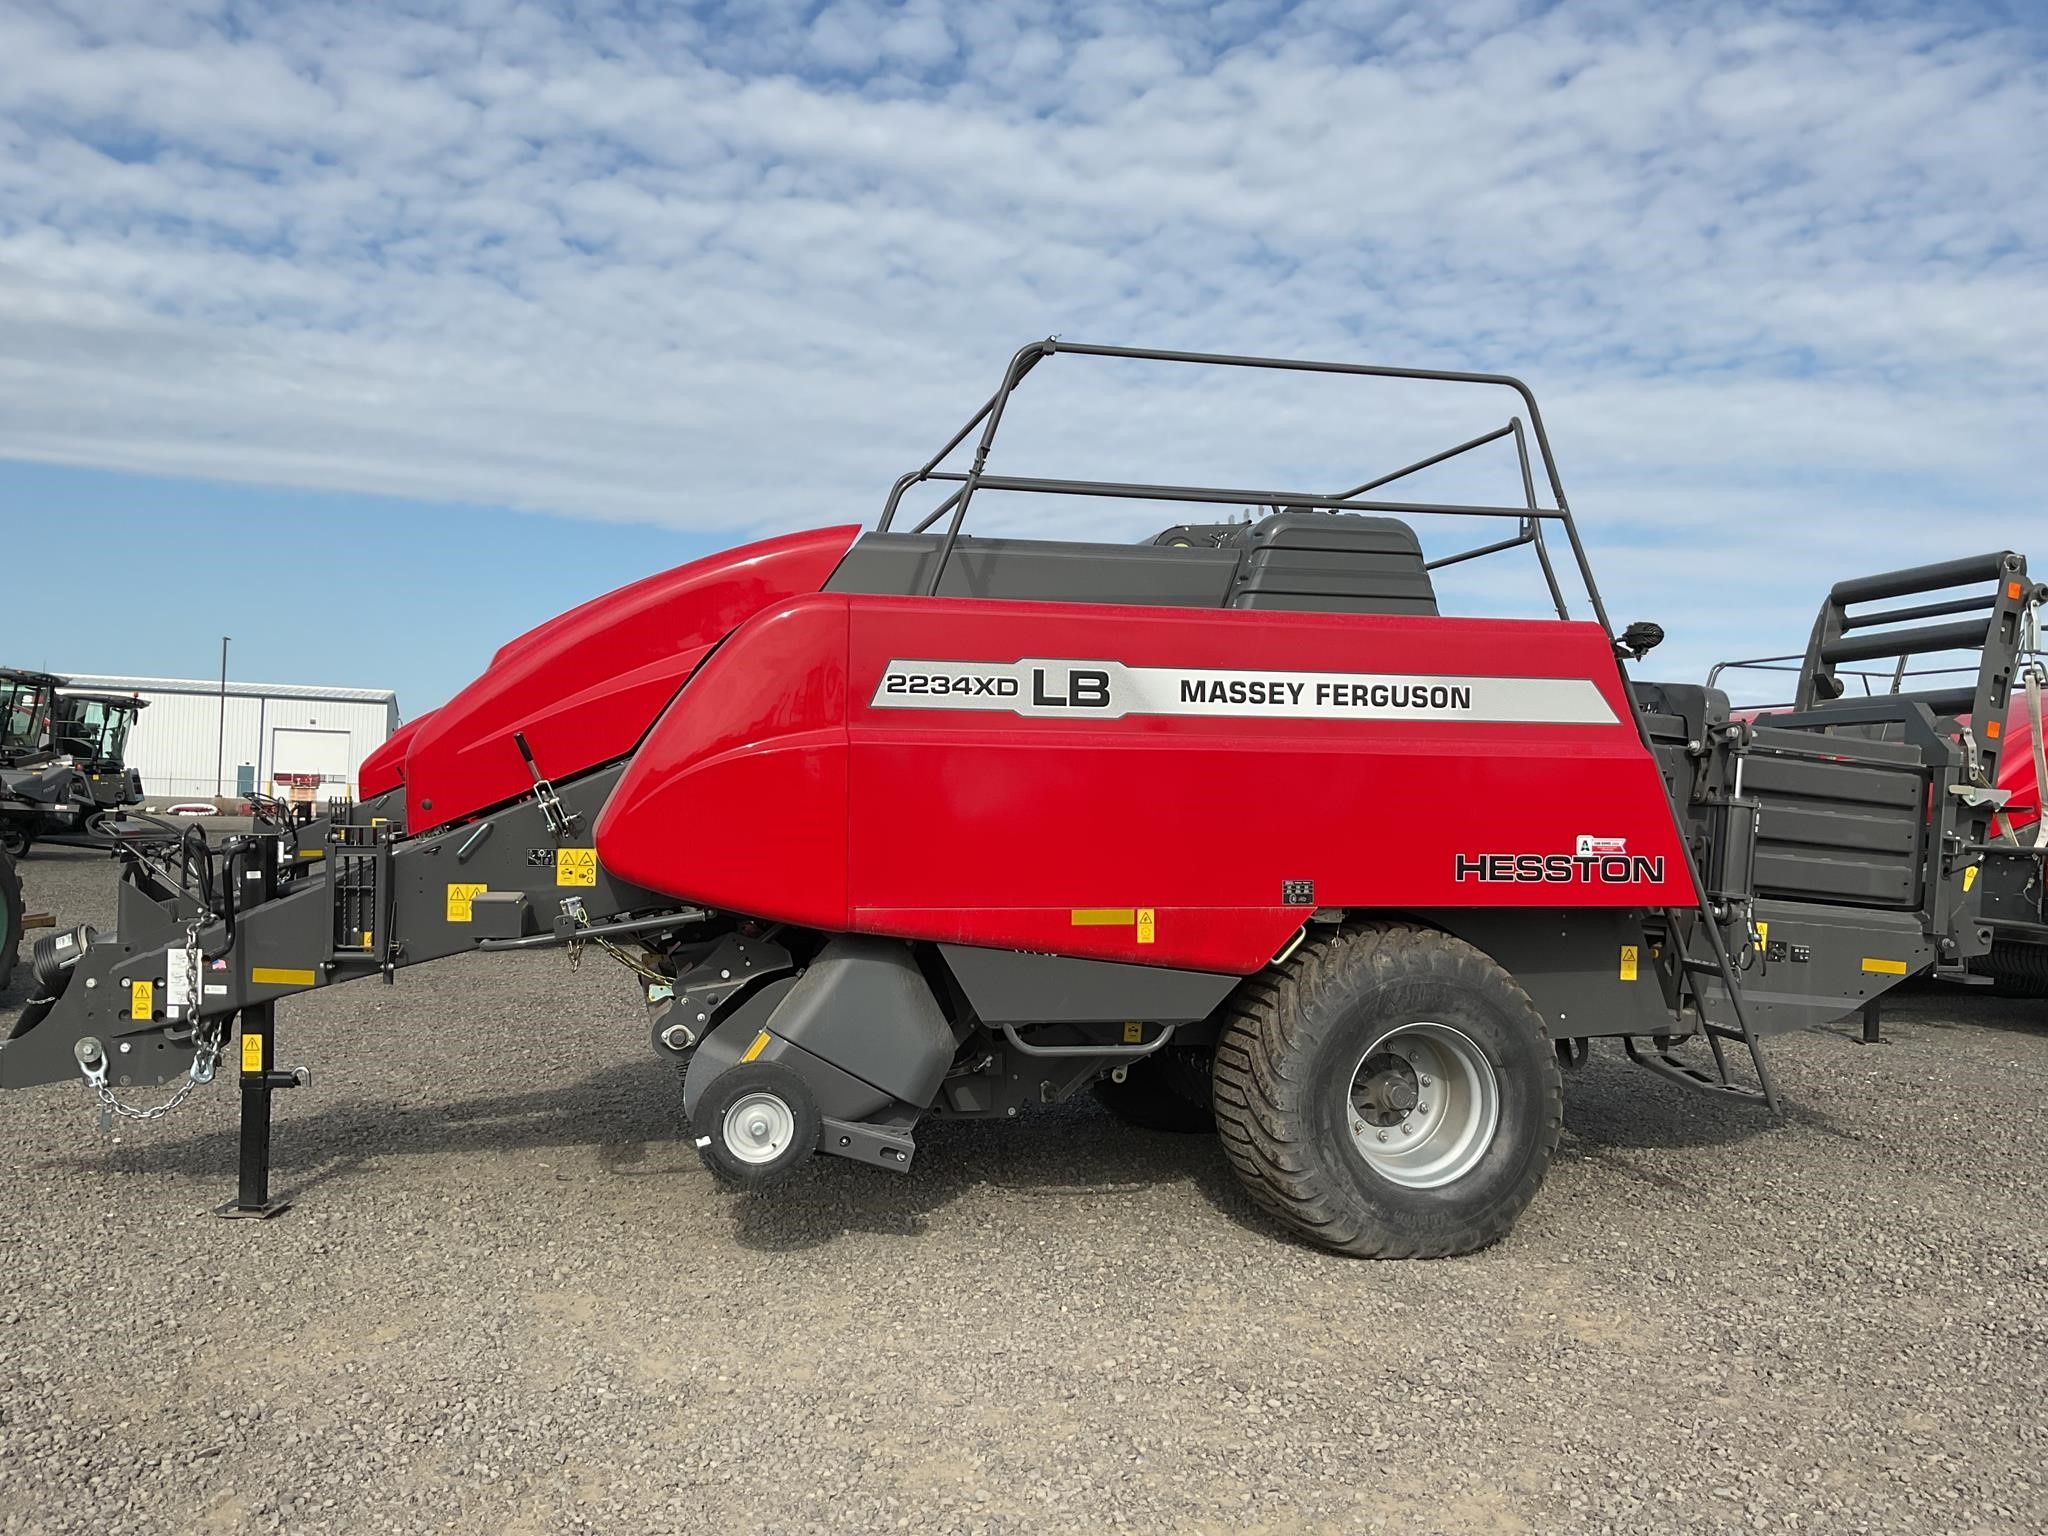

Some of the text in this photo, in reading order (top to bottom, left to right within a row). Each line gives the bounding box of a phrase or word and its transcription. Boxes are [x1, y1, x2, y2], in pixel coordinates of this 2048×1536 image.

[886, 668, 1111, 708] 2234XD LB
[1180, 679, 1471, 709] MASSEY FERGUSON
[1456, 854, 1664, 883] HESSTON
